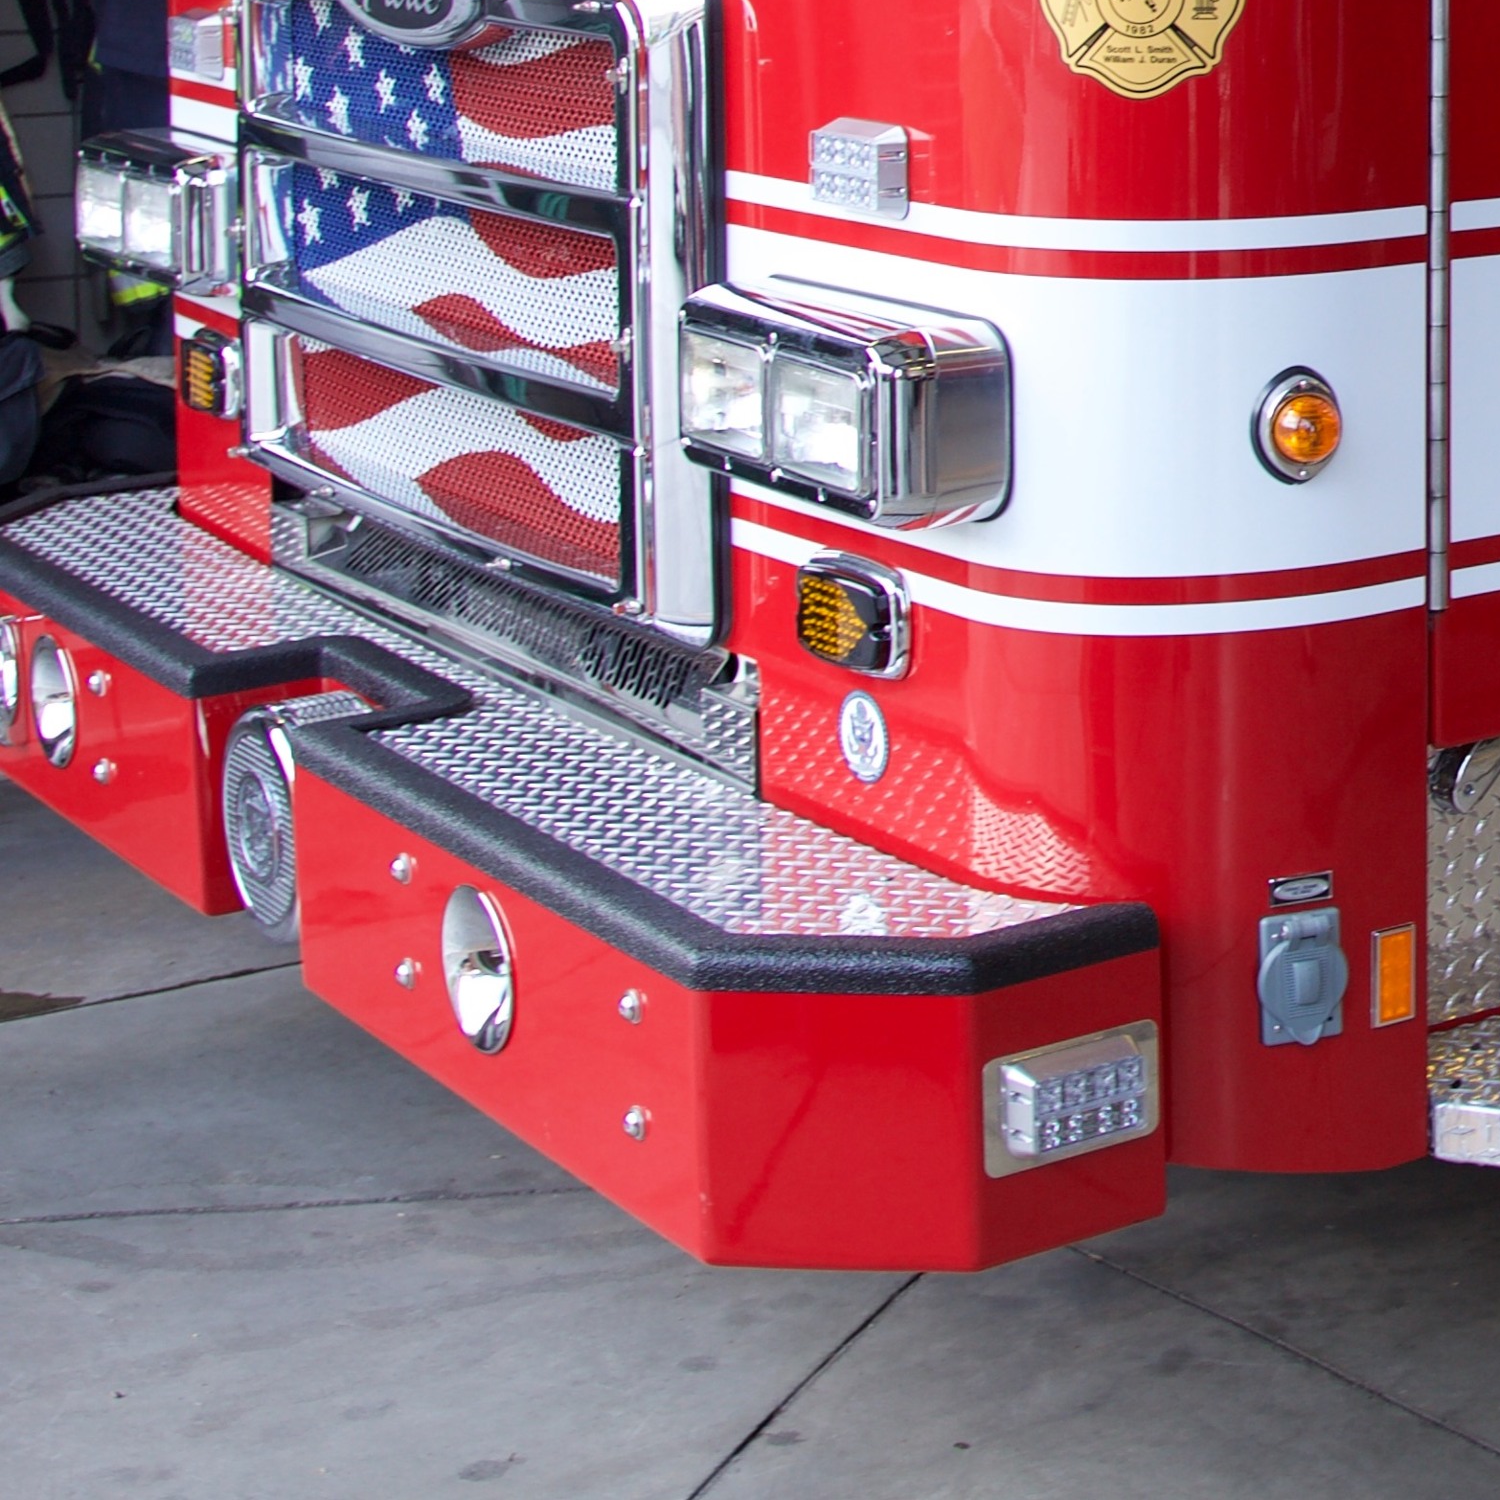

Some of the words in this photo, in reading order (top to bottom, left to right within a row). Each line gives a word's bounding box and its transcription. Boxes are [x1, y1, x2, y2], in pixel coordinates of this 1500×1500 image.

[1125, 24, 1155, 35] 1982
[1106, 45, 1132, 54] Scott
[1146, 44, 1175, 54] Smith
[1103, 54, 1136, 64] William
